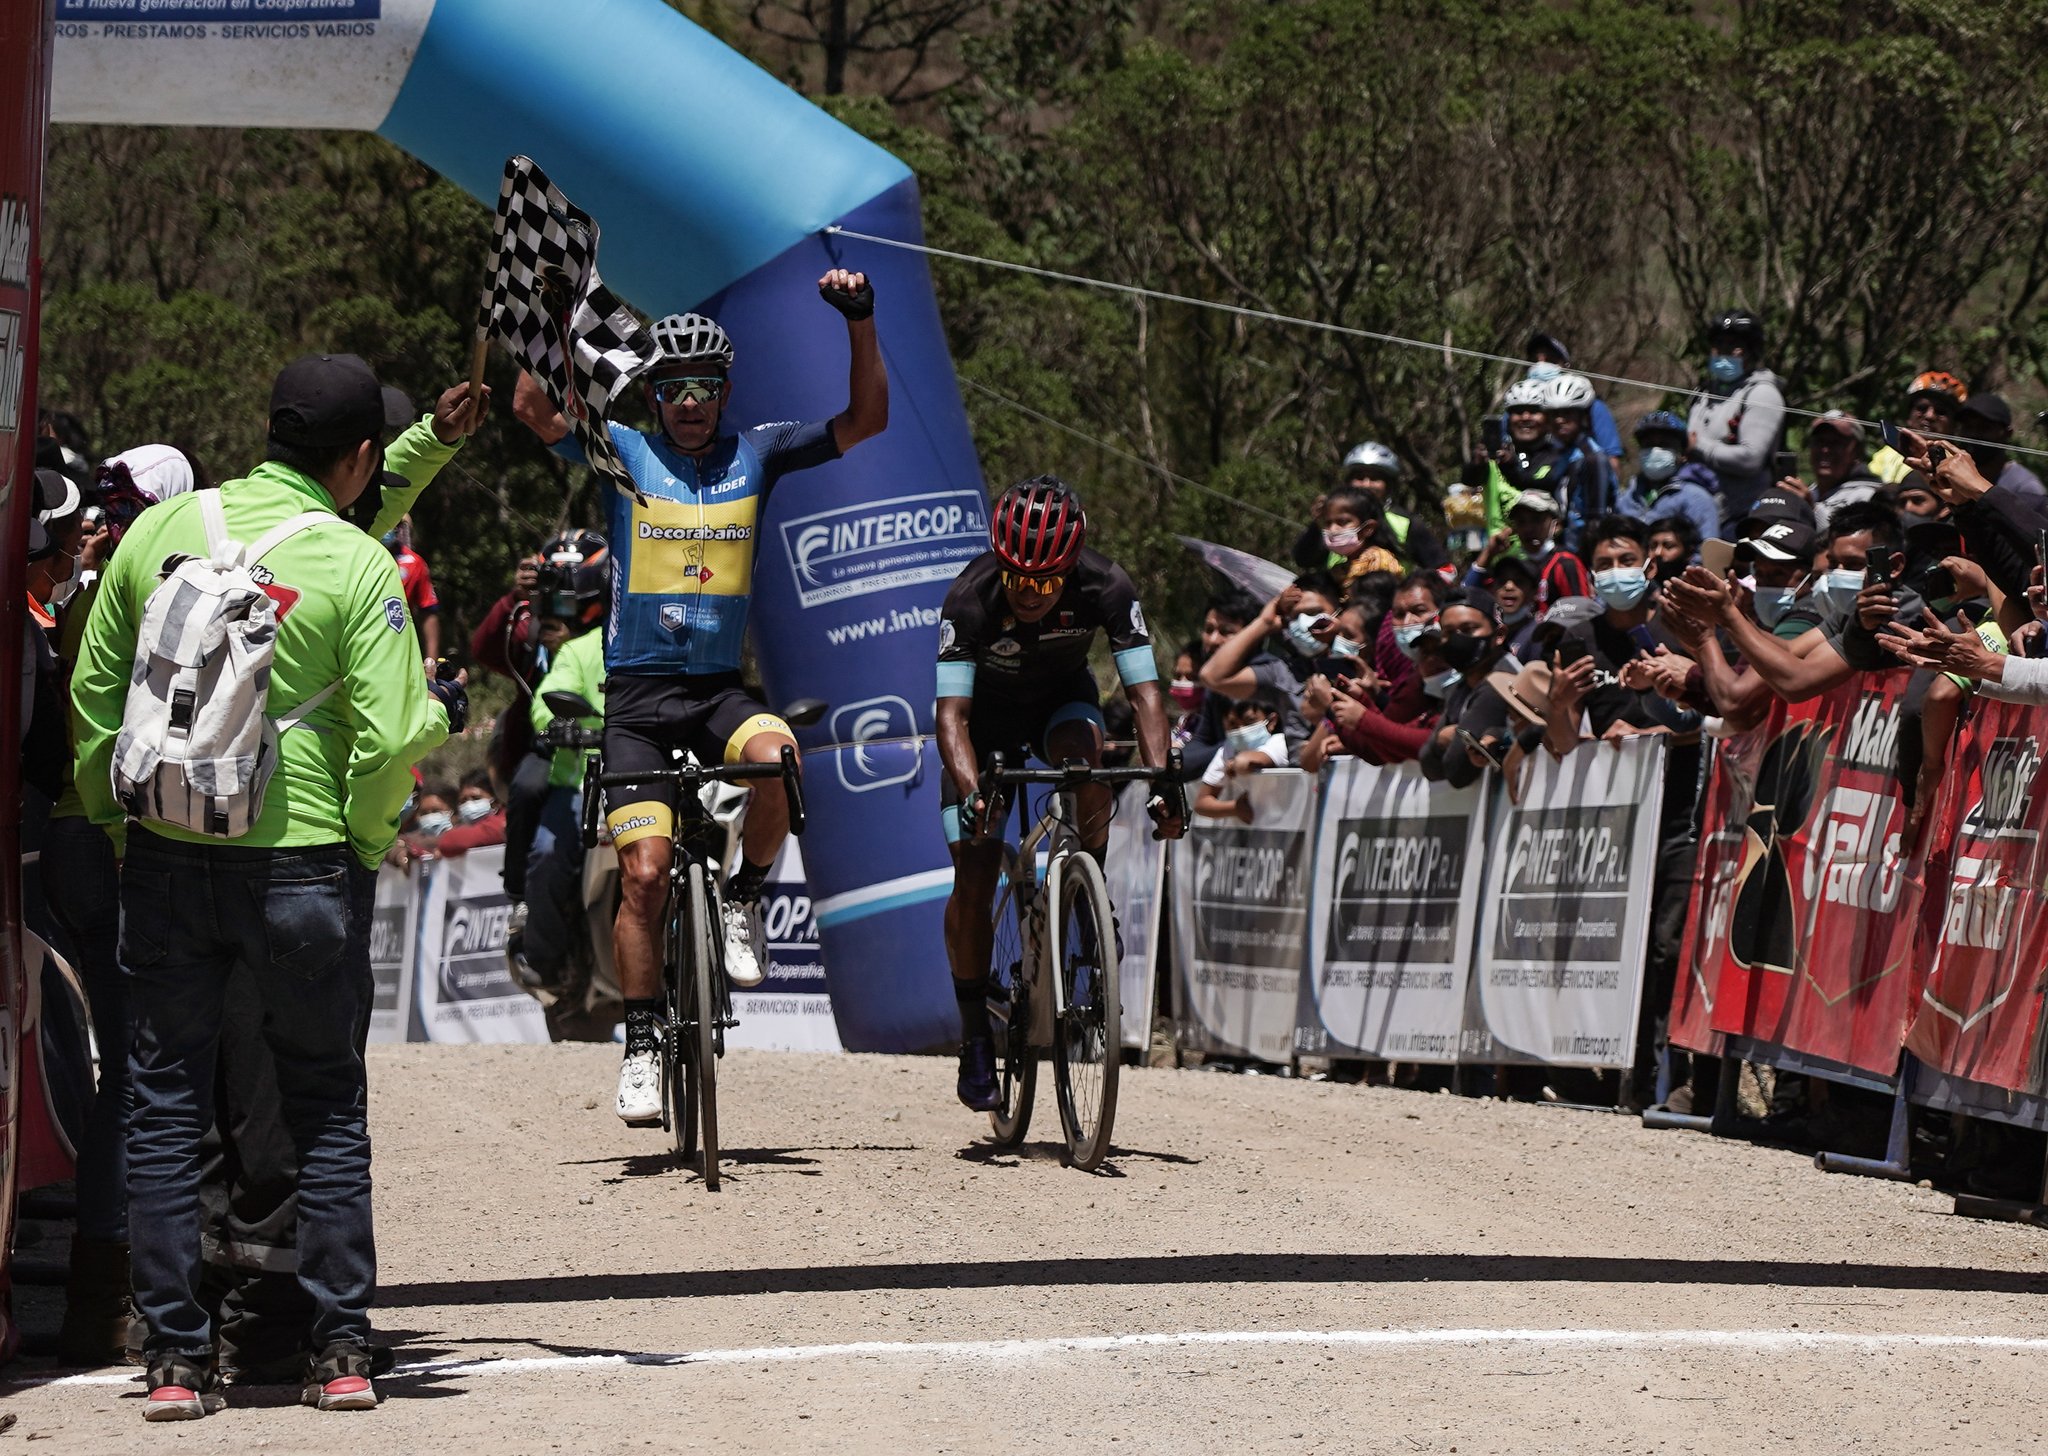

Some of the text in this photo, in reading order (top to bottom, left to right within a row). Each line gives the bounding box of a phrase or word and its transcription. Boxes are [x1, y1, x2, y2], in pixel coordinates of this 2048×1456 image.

[104, 24, 207, 38] PRESTAMOS
[221, 23, 309, 38] SERVICIOS
[312, 22, 375, 37] VARIOS
[710, 476, 747, 495] LIDER
[639, 519, 753, 541] Decorabaños
